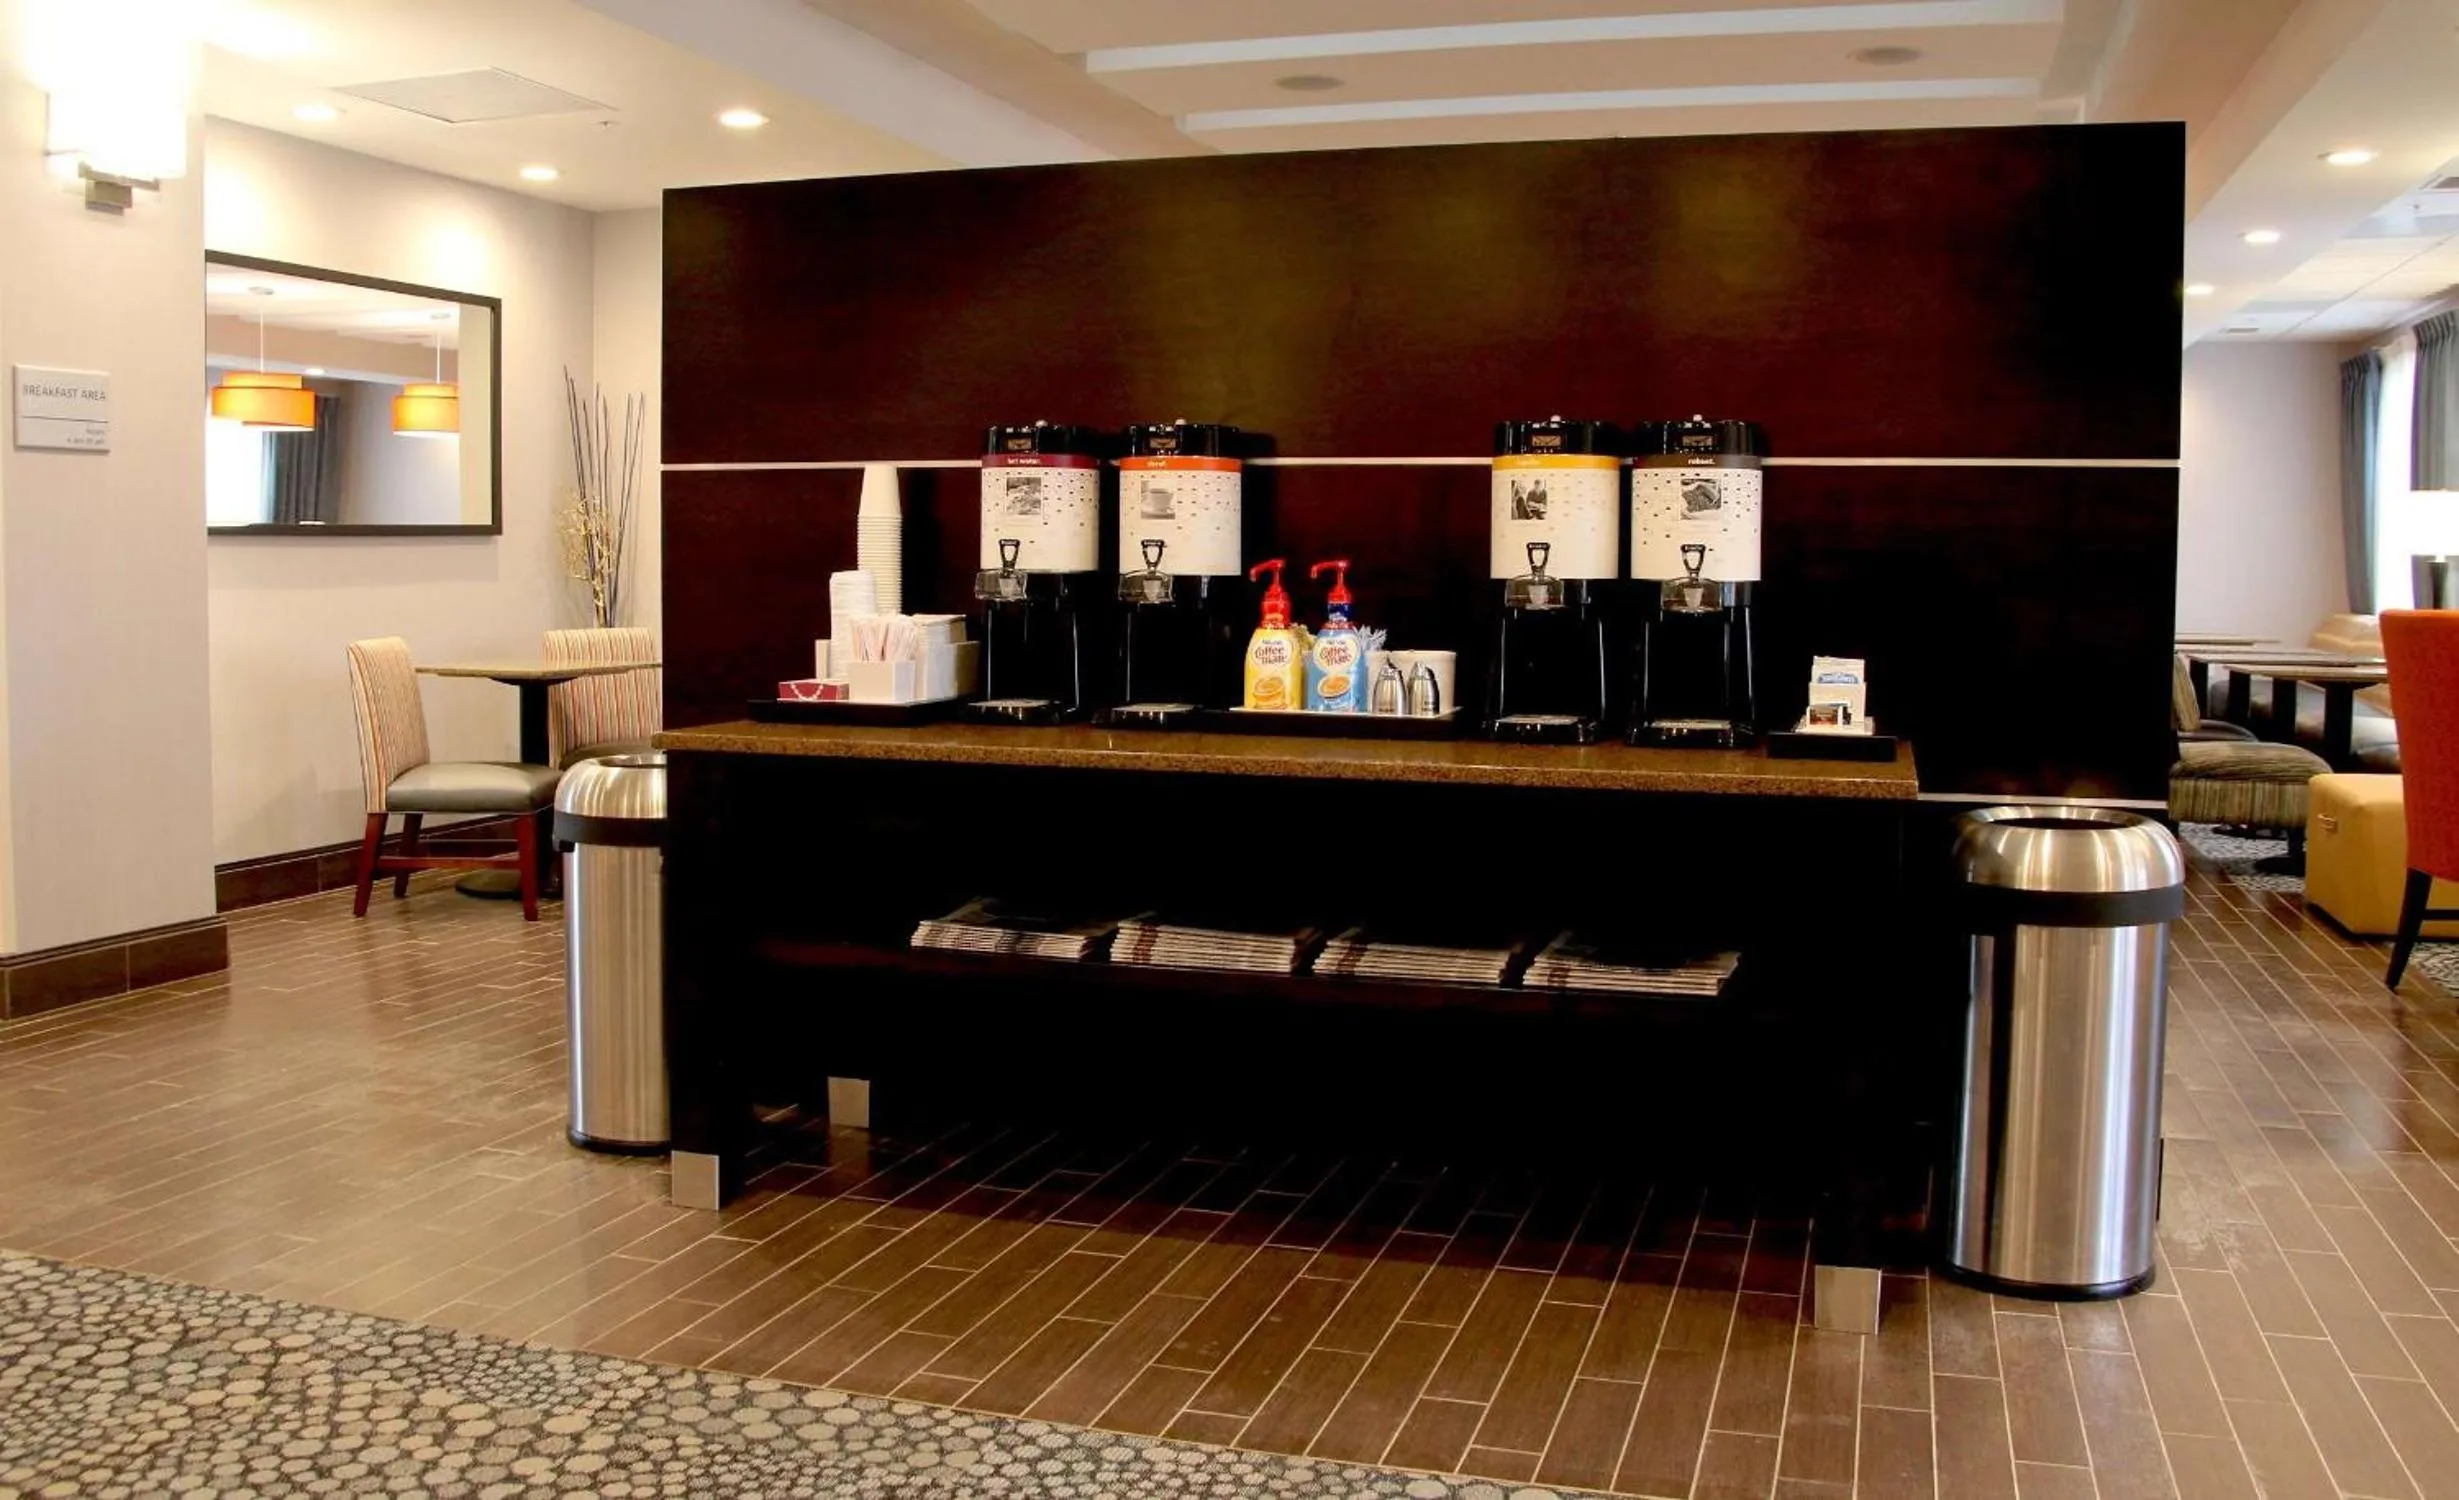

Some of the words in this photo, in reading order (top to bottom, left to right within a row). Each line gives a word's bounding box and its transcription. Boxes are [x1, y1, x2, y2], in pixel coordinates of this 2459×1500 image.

[23, 383, 77, 398] BREAKFAST
[81, 388, 106, 400] AREA
[1255, 645, 1285, 658] Coffee
